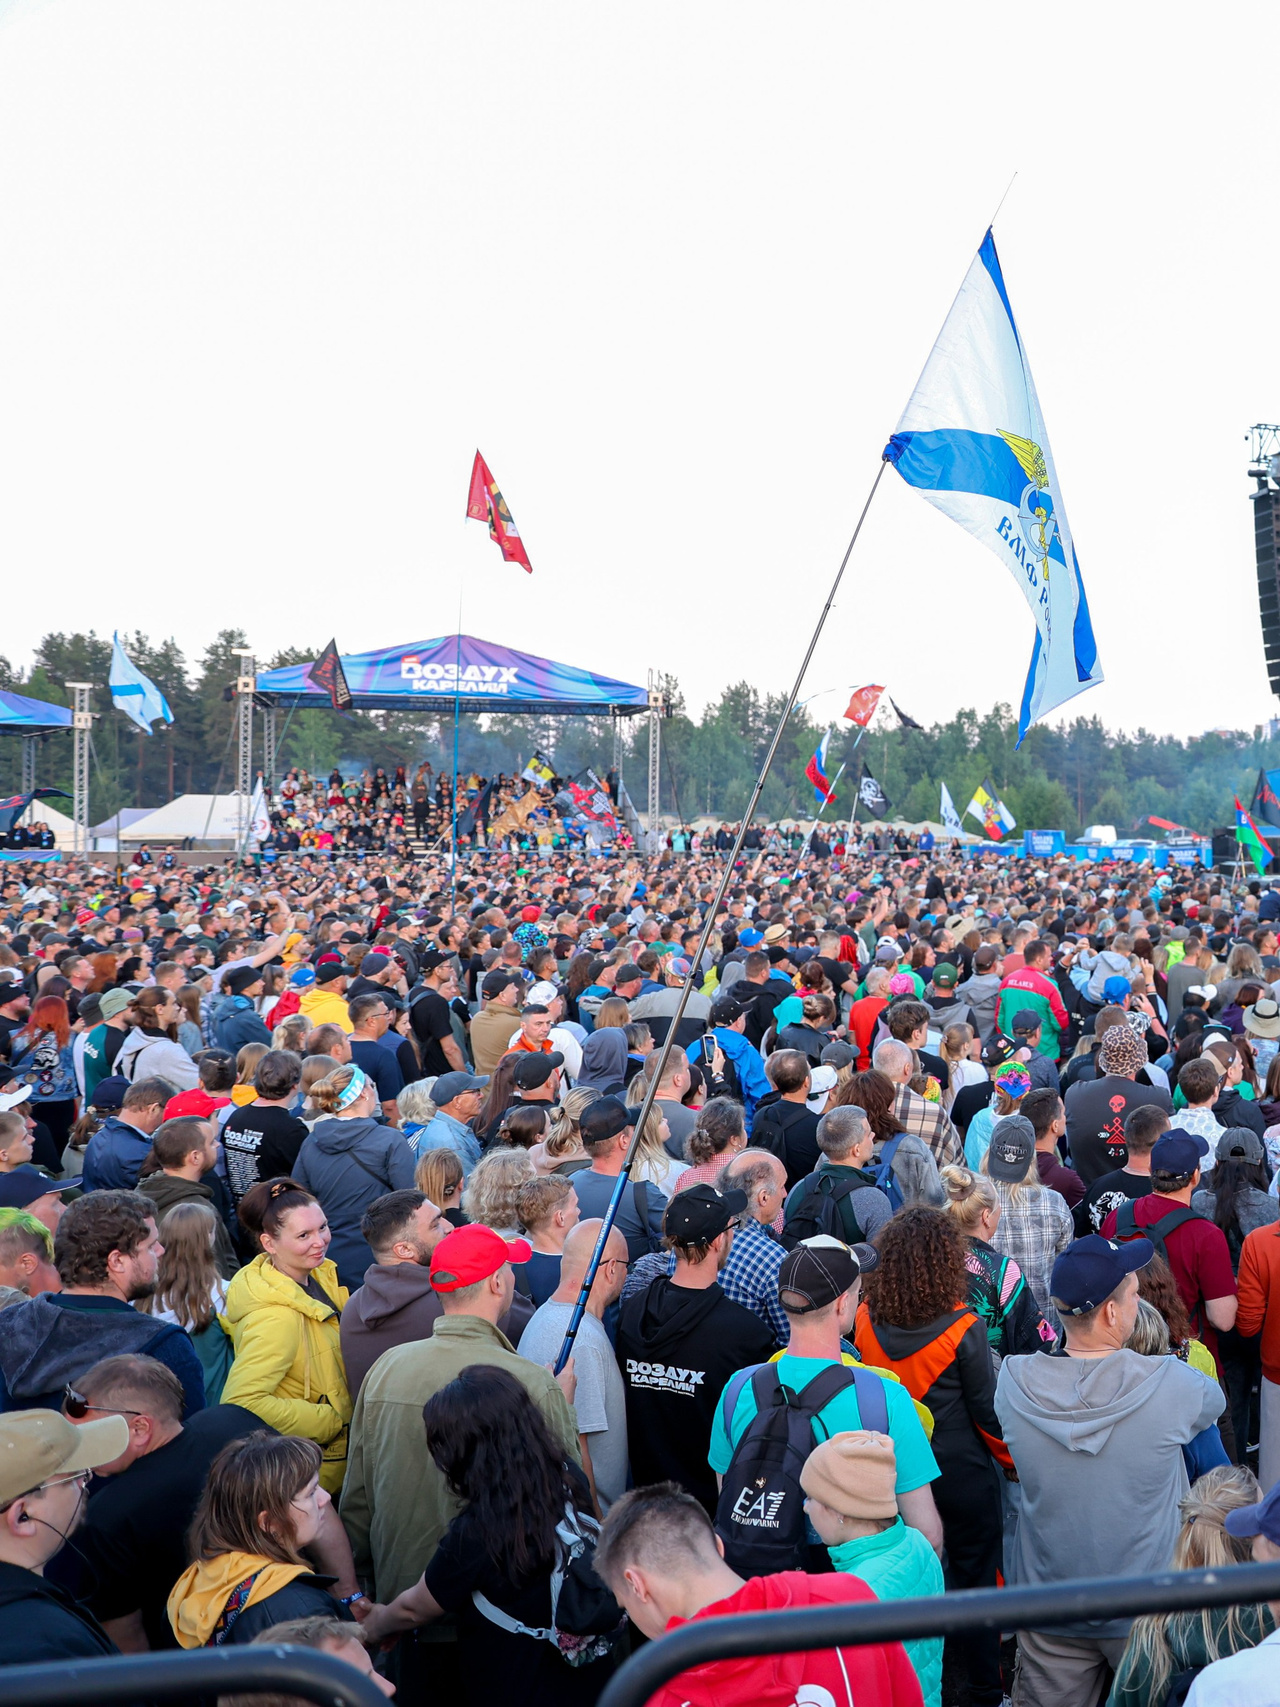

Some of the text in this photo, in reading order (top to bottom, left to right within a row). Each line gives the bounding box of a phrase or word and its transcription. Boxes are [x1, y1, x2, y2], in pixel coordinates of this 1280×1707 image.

[994, 515, 1038, 588] ВМФ
[401, 662, 519, 684] ВОЗДУХ
[412, 679, 508, 693] КАРЕЛИИ
[1007, 979, 1034, 989] BELARUS
[224, 1129, 262, 1146] ВОЗДУХ
[626, 1359, 706, 1385] ВОЗДУХ
[630, 1373, 695, 1394] КАРЕЛИИ
[733, 1486, 786, 1520] EA7
